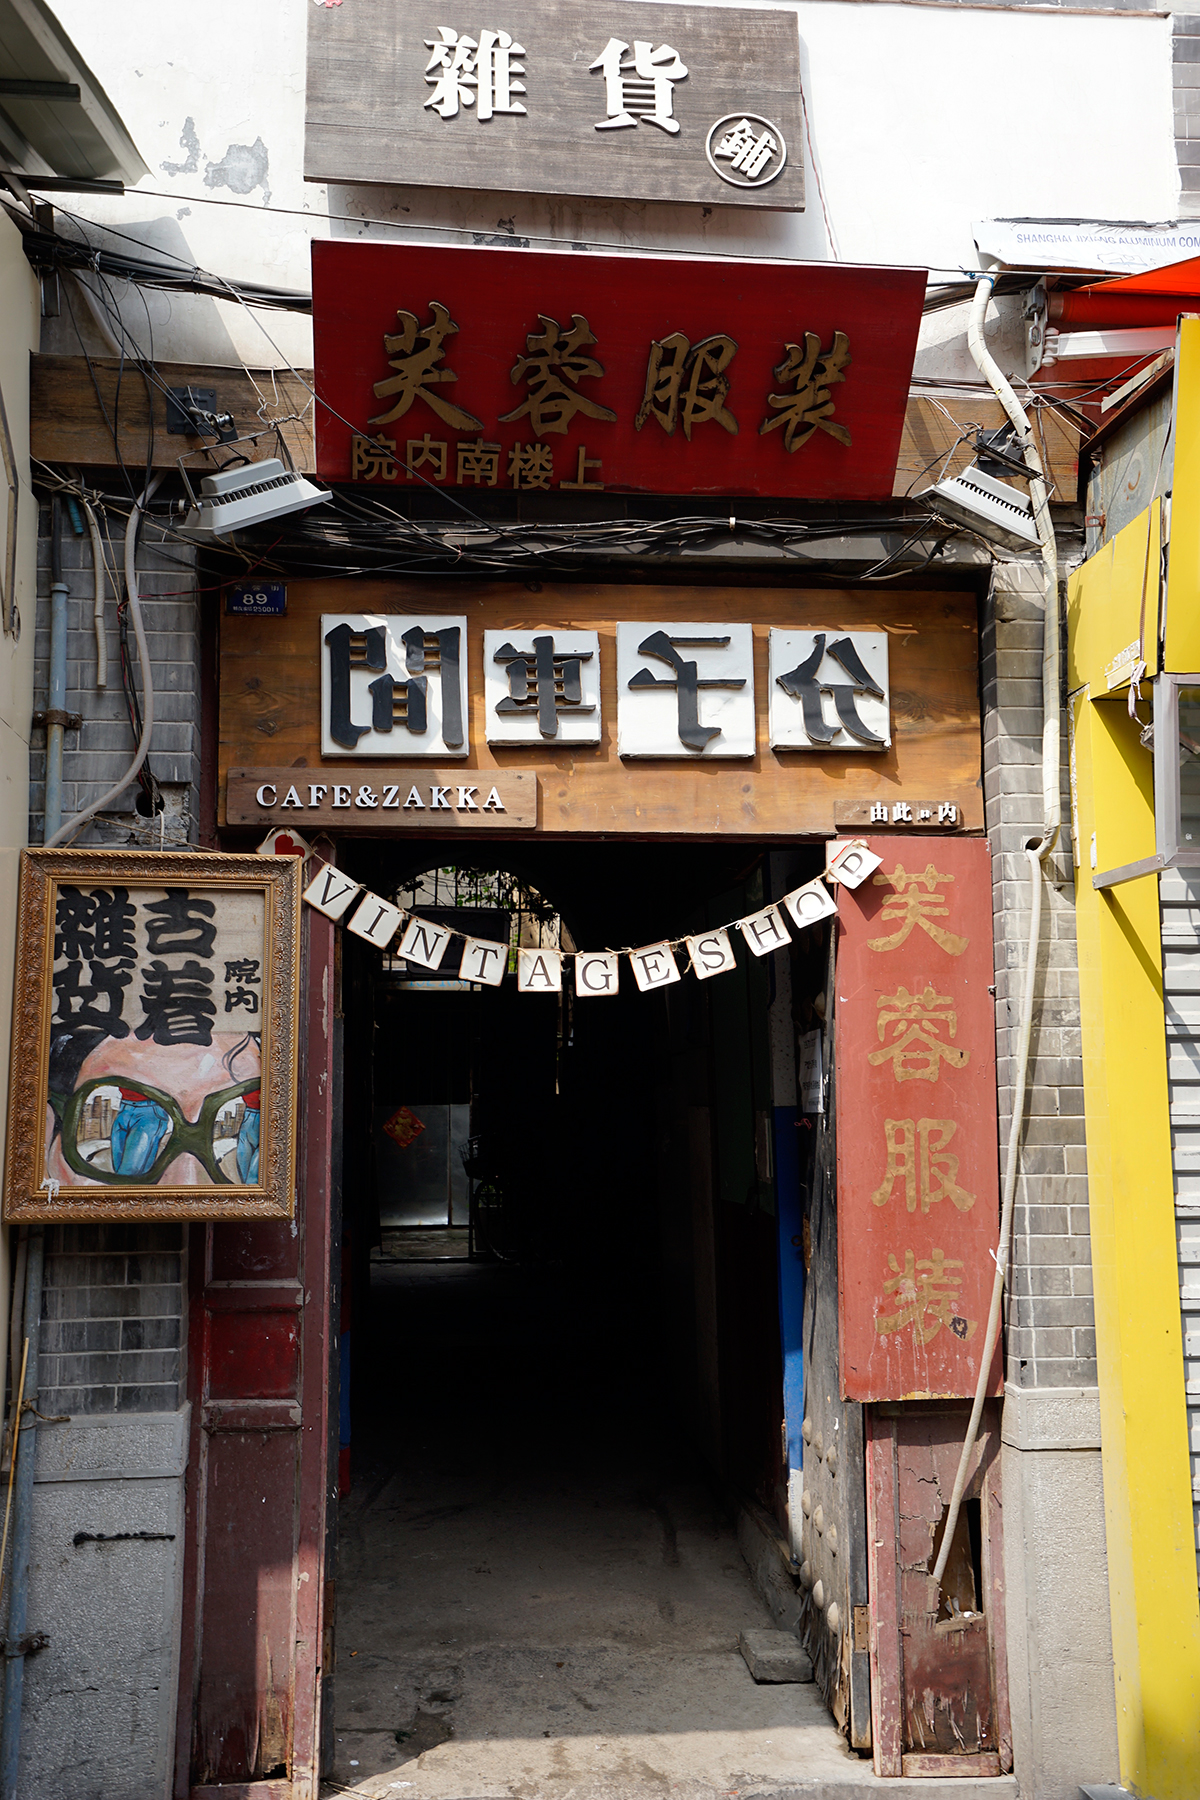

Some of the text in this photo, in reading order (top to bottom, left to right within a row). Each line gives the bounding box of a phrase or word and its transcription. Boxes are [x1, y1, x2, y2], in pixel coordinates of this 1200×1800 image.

[1016, 233, 1072, 244] SHANGHAI
[1118, 236, 1177, 248] ALUMINUM
[367, 301, 852, 454] 芙蓉服装
[351, 432, 605, 491] 院内南楼上
[242, 593, 268, 605] 89
[256, 784, 505, 809] CAFE&ZAKKA
[224, 958, 261, 1014] 院内
[866, 863, 979, 1346] 芙蓉服装
